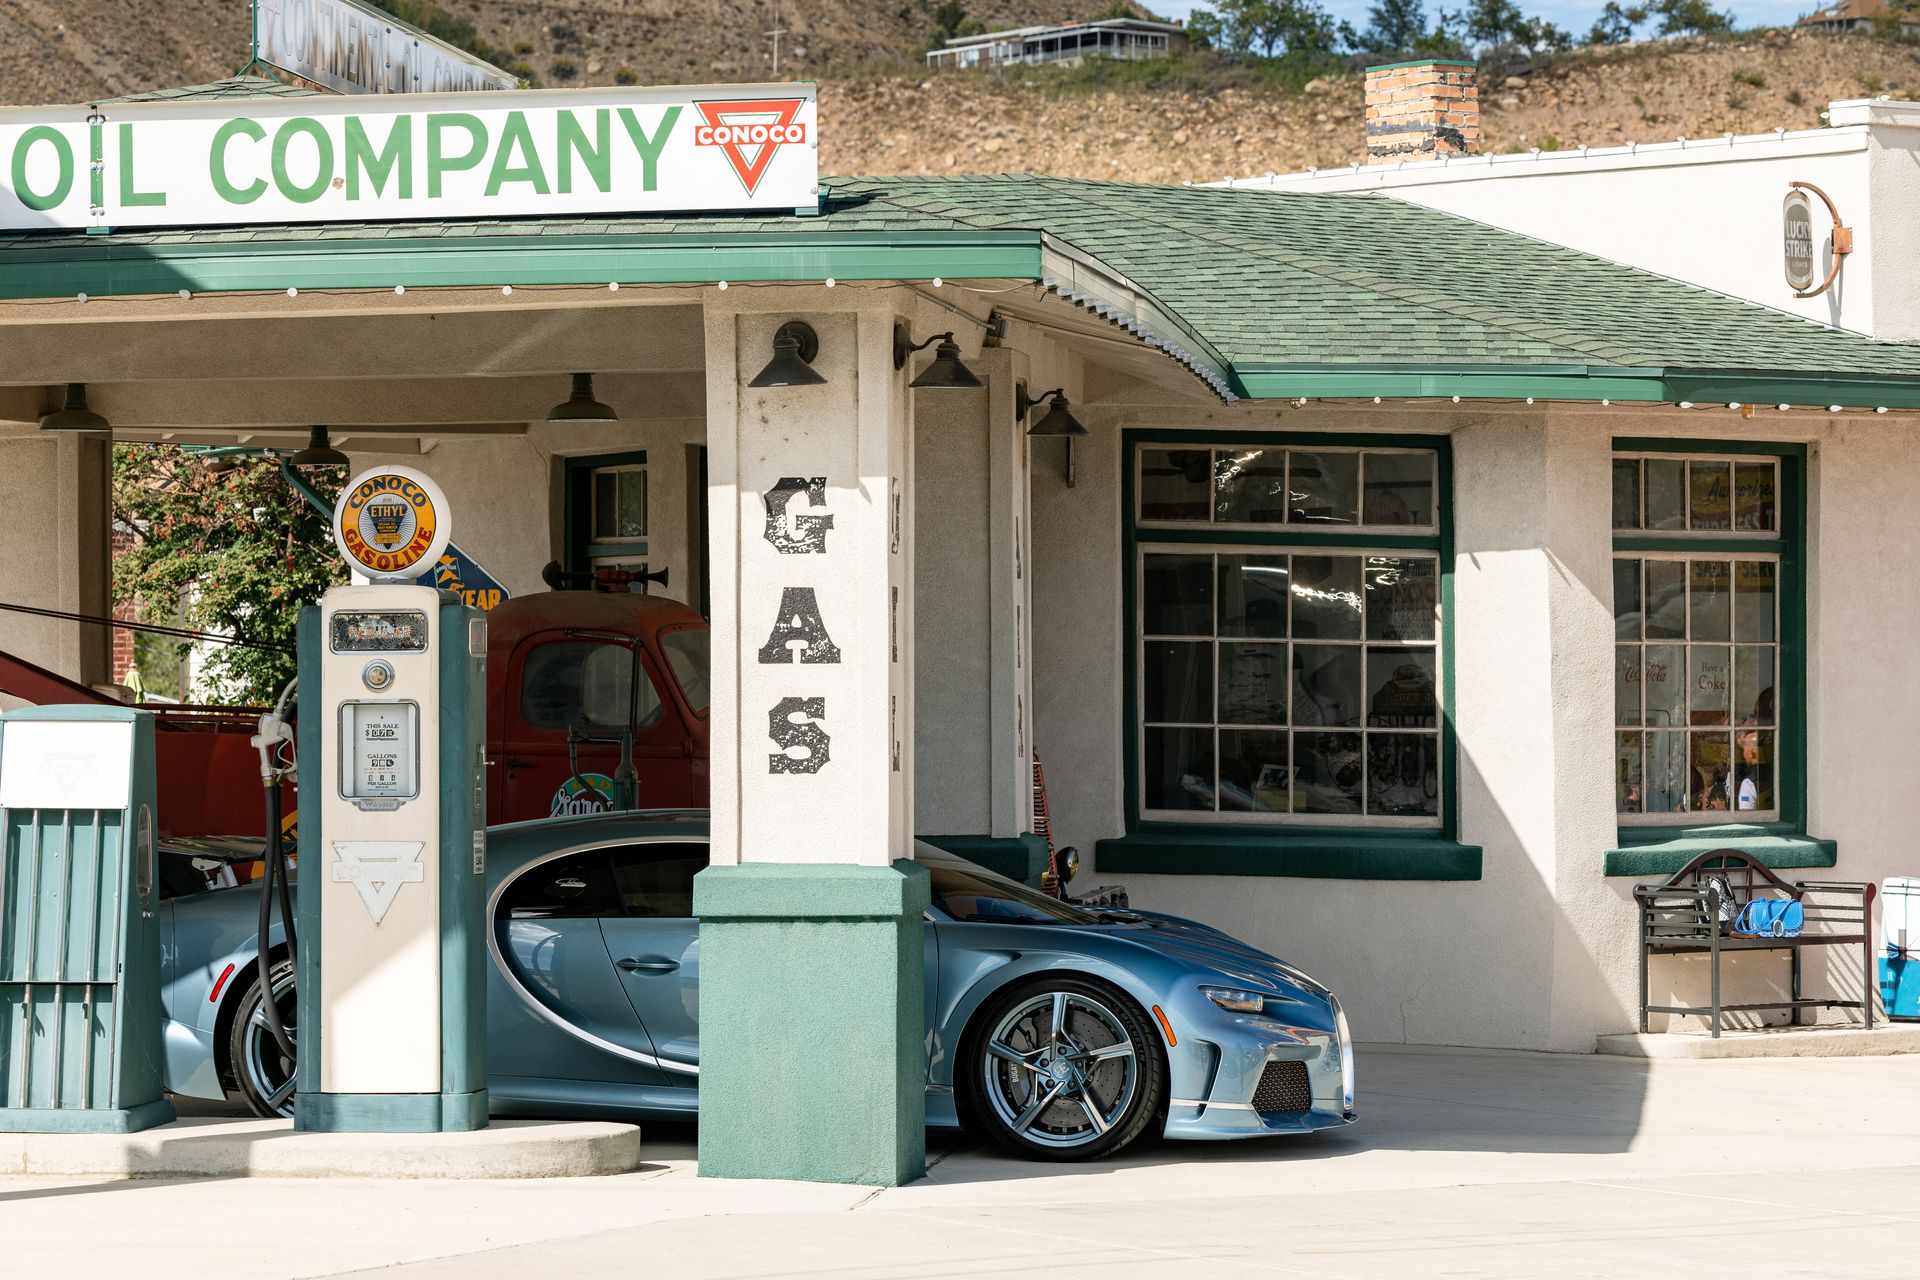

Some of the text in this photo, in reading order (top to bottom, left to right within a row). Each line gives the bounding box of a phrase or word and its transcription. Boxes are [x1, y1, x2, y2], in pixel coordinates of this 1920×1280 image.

[697, 124, 803, 145] CONOCO
[11, 106, 683, 211] OIL COMPANY
[1786, 220, 1811, 239] LUCKY
[1785, 240, 1813, 258] STRIKE
[350, 477, 427, 509] CONOCO
[1708, 476, 1774, 500] Auhorize
[371, 505, 405, 517] ETHYL
[345, 526, 432, 570] GASOLINE
[461, 589, 501, 611] EAR
[757, 477, 842, 774] GAS
[1701, 662, 1719, 673] Have
[1698, 674, 1726, 690] Coke
[1011, 1062, 1020, 1083] BUGAT
